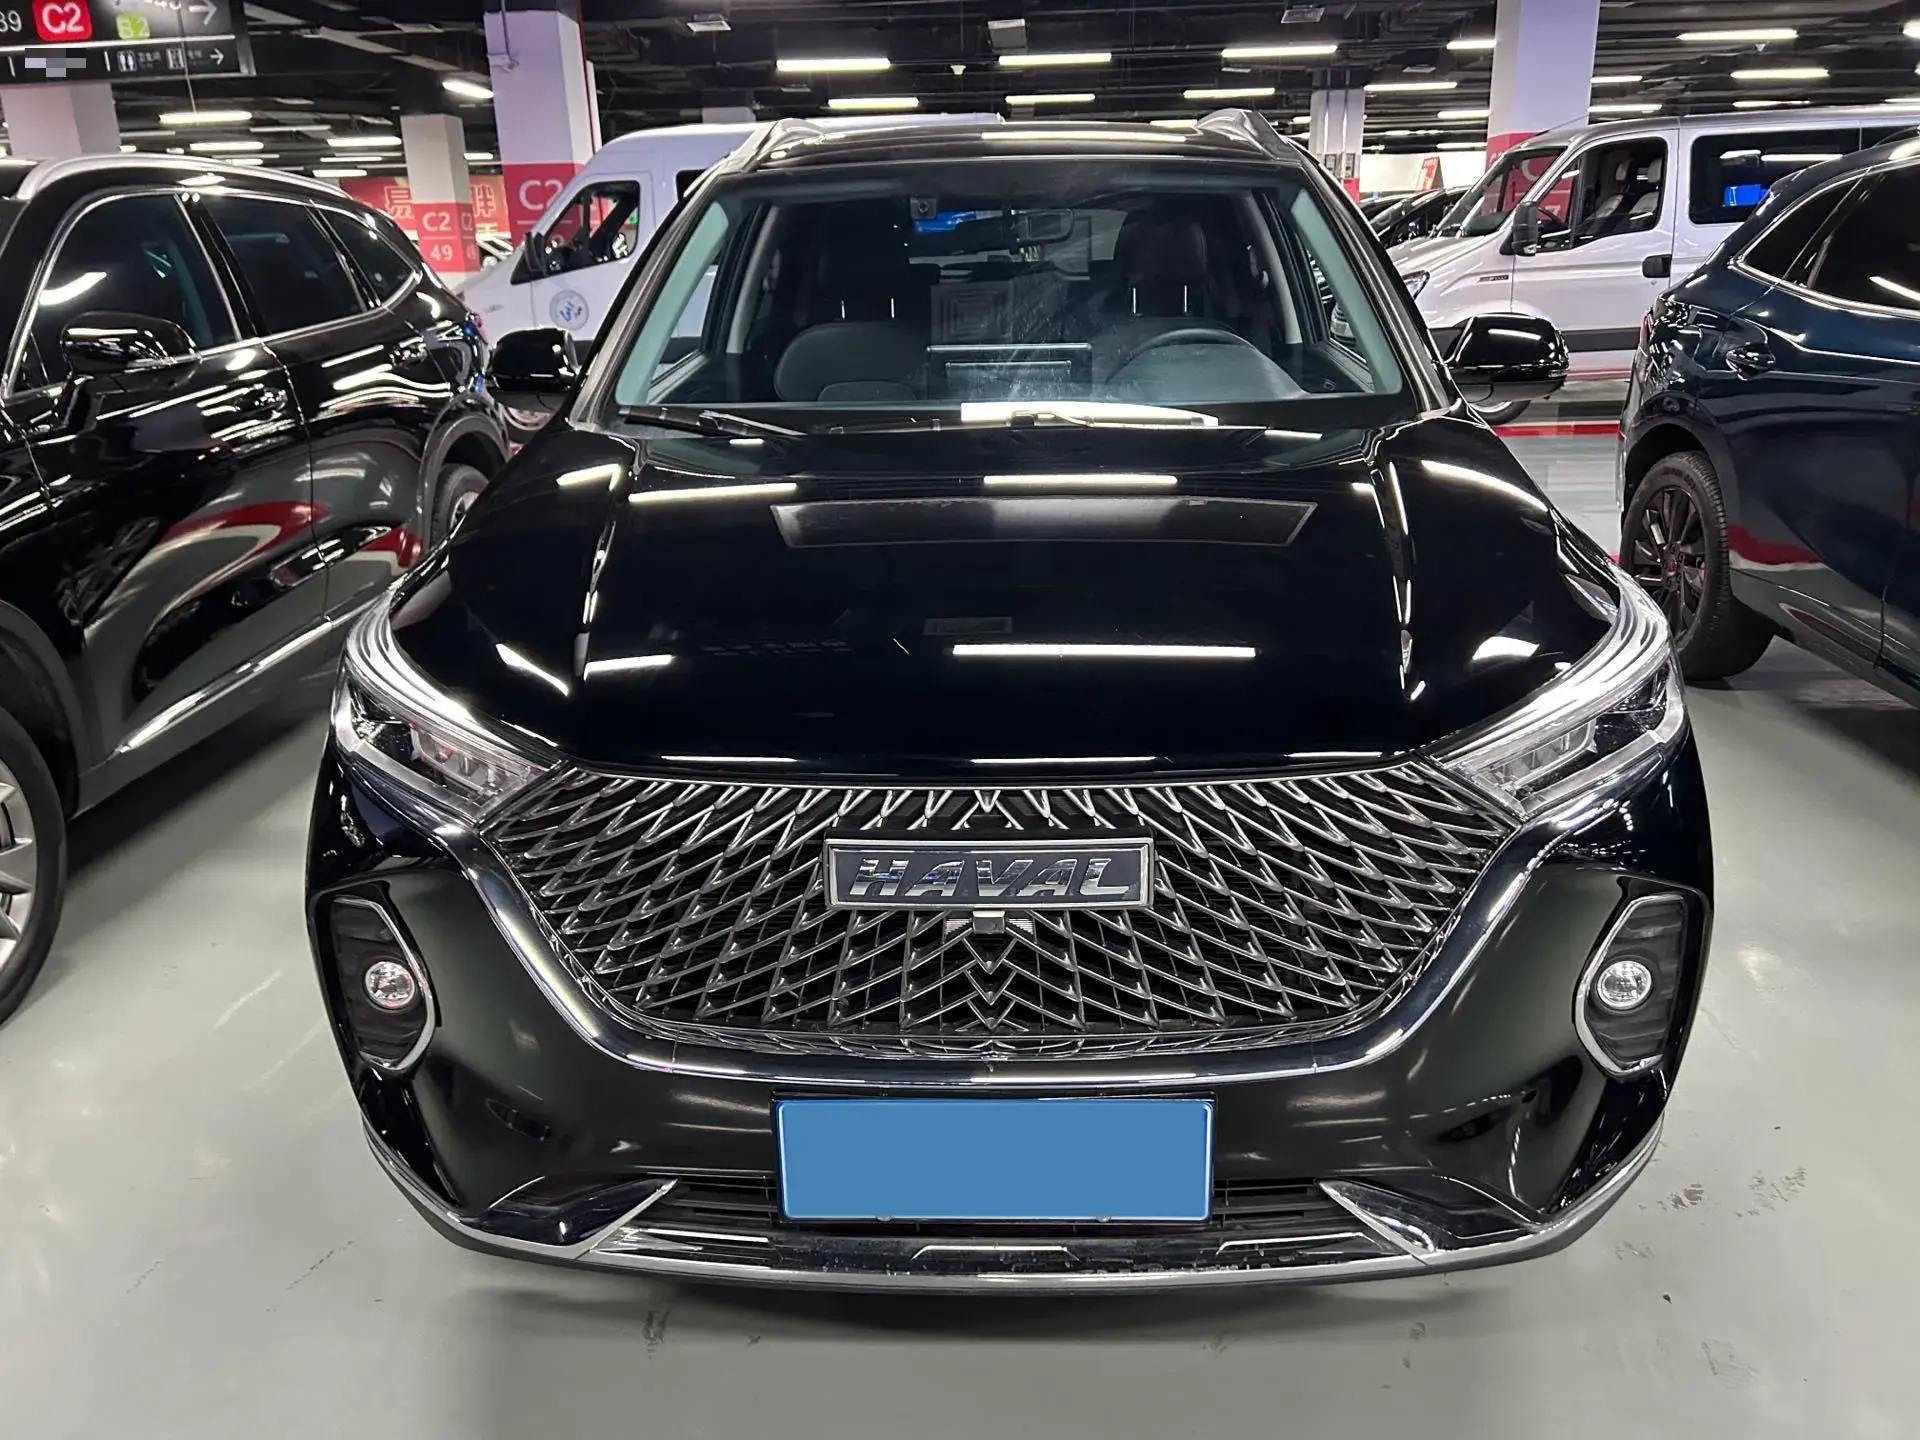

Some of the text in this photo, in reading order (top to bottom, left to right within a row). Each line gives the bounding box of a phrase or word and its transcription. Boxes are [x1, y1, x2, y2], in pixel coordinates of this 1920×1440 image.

[42, 2, 85, 34] C2
[519, 179, 563, 211] C2
[422, 211, 452, 232] C2
[429, 245, 453, 261] 49
[849, 858, 1131, 897] HAVAL
